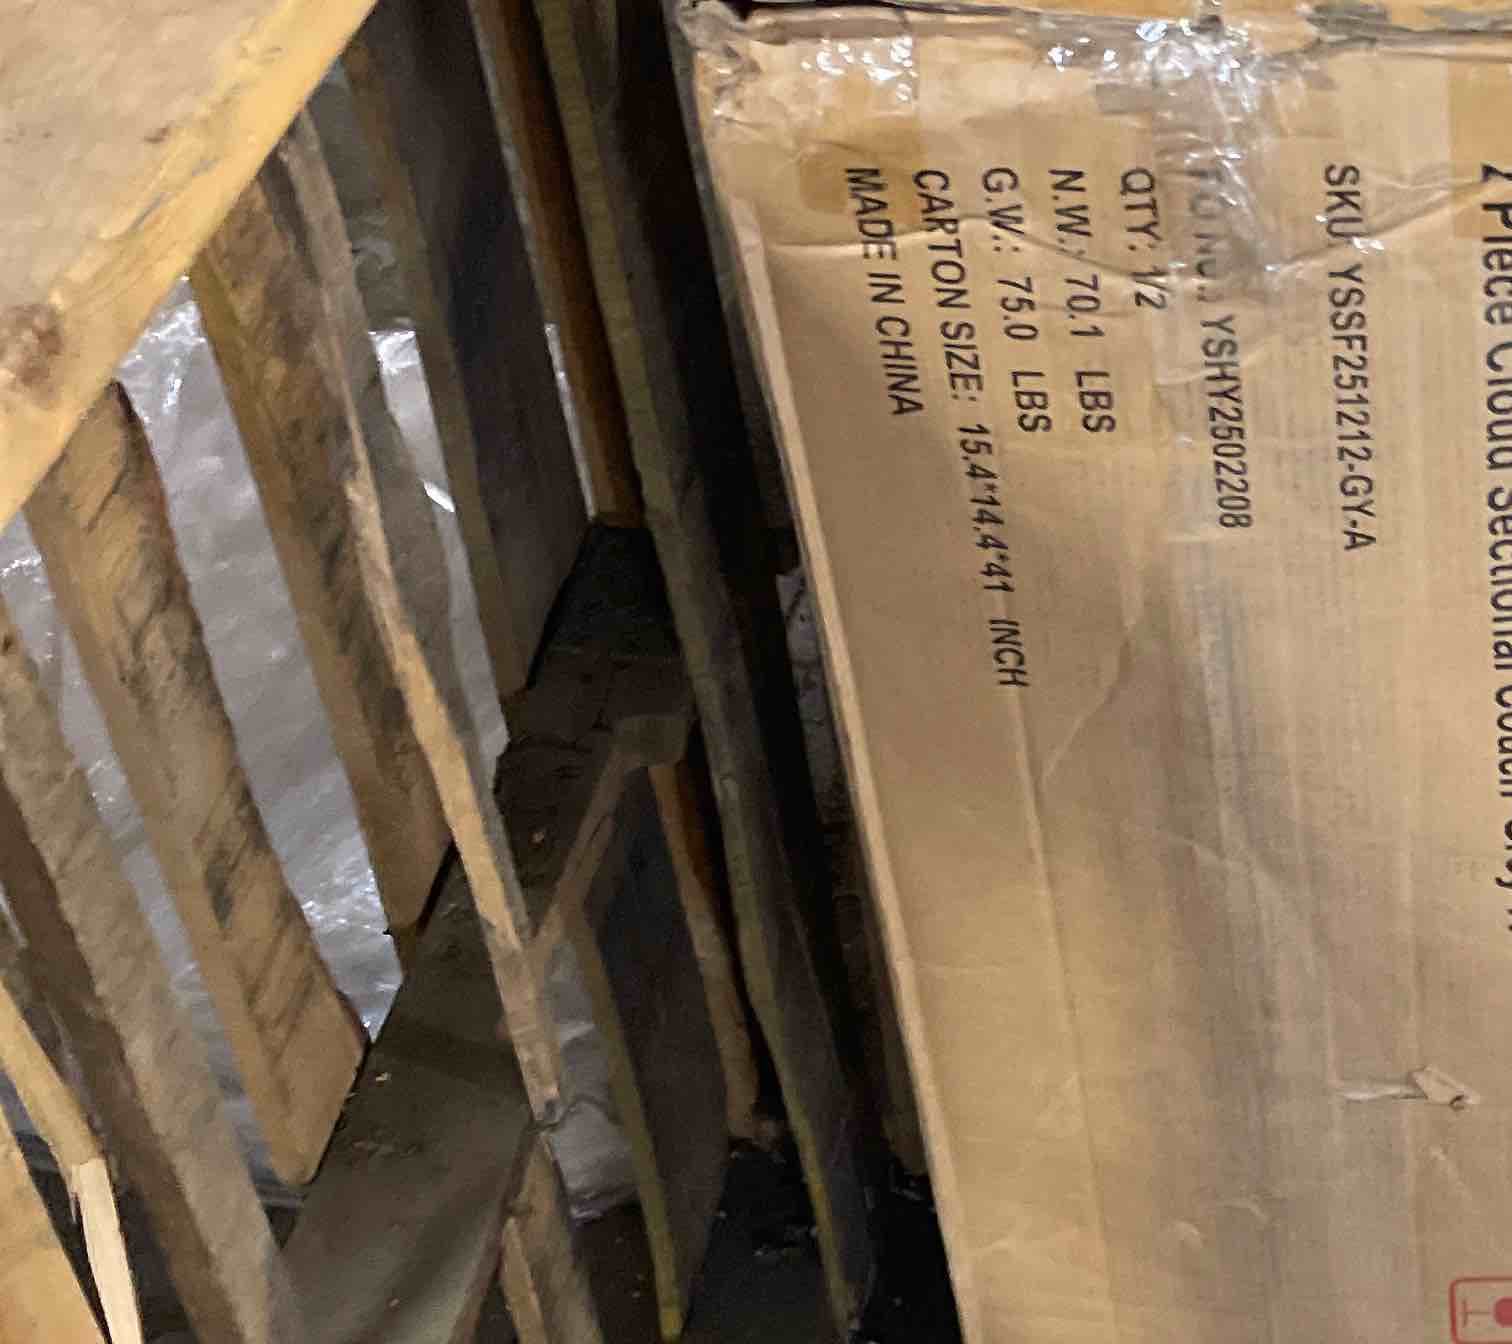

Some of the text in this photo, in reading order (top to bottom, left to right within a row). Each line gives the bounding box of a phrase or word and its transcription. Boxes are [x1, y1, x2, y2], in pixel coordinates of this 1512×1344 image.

[844, 167, 925, 415] MADE IN CHINA
[912, 168, 972, 309] CARTON
[982, 167, 1052, 432] G.W.: 75.0 LBS
[1065, 273, 1105, 338] 70.1
[1119, 166, 1169, 310] QTY: 1/2
[939, 321, 984, 401] SIZE:
[1074, 370, 1116, 433] LBS
[1200, 314, 1253, 529] YSHY2502208
[1327, 263, 1378, 551] YSSF251212-GY-A
[988, 619, 1030, 688] INCH
